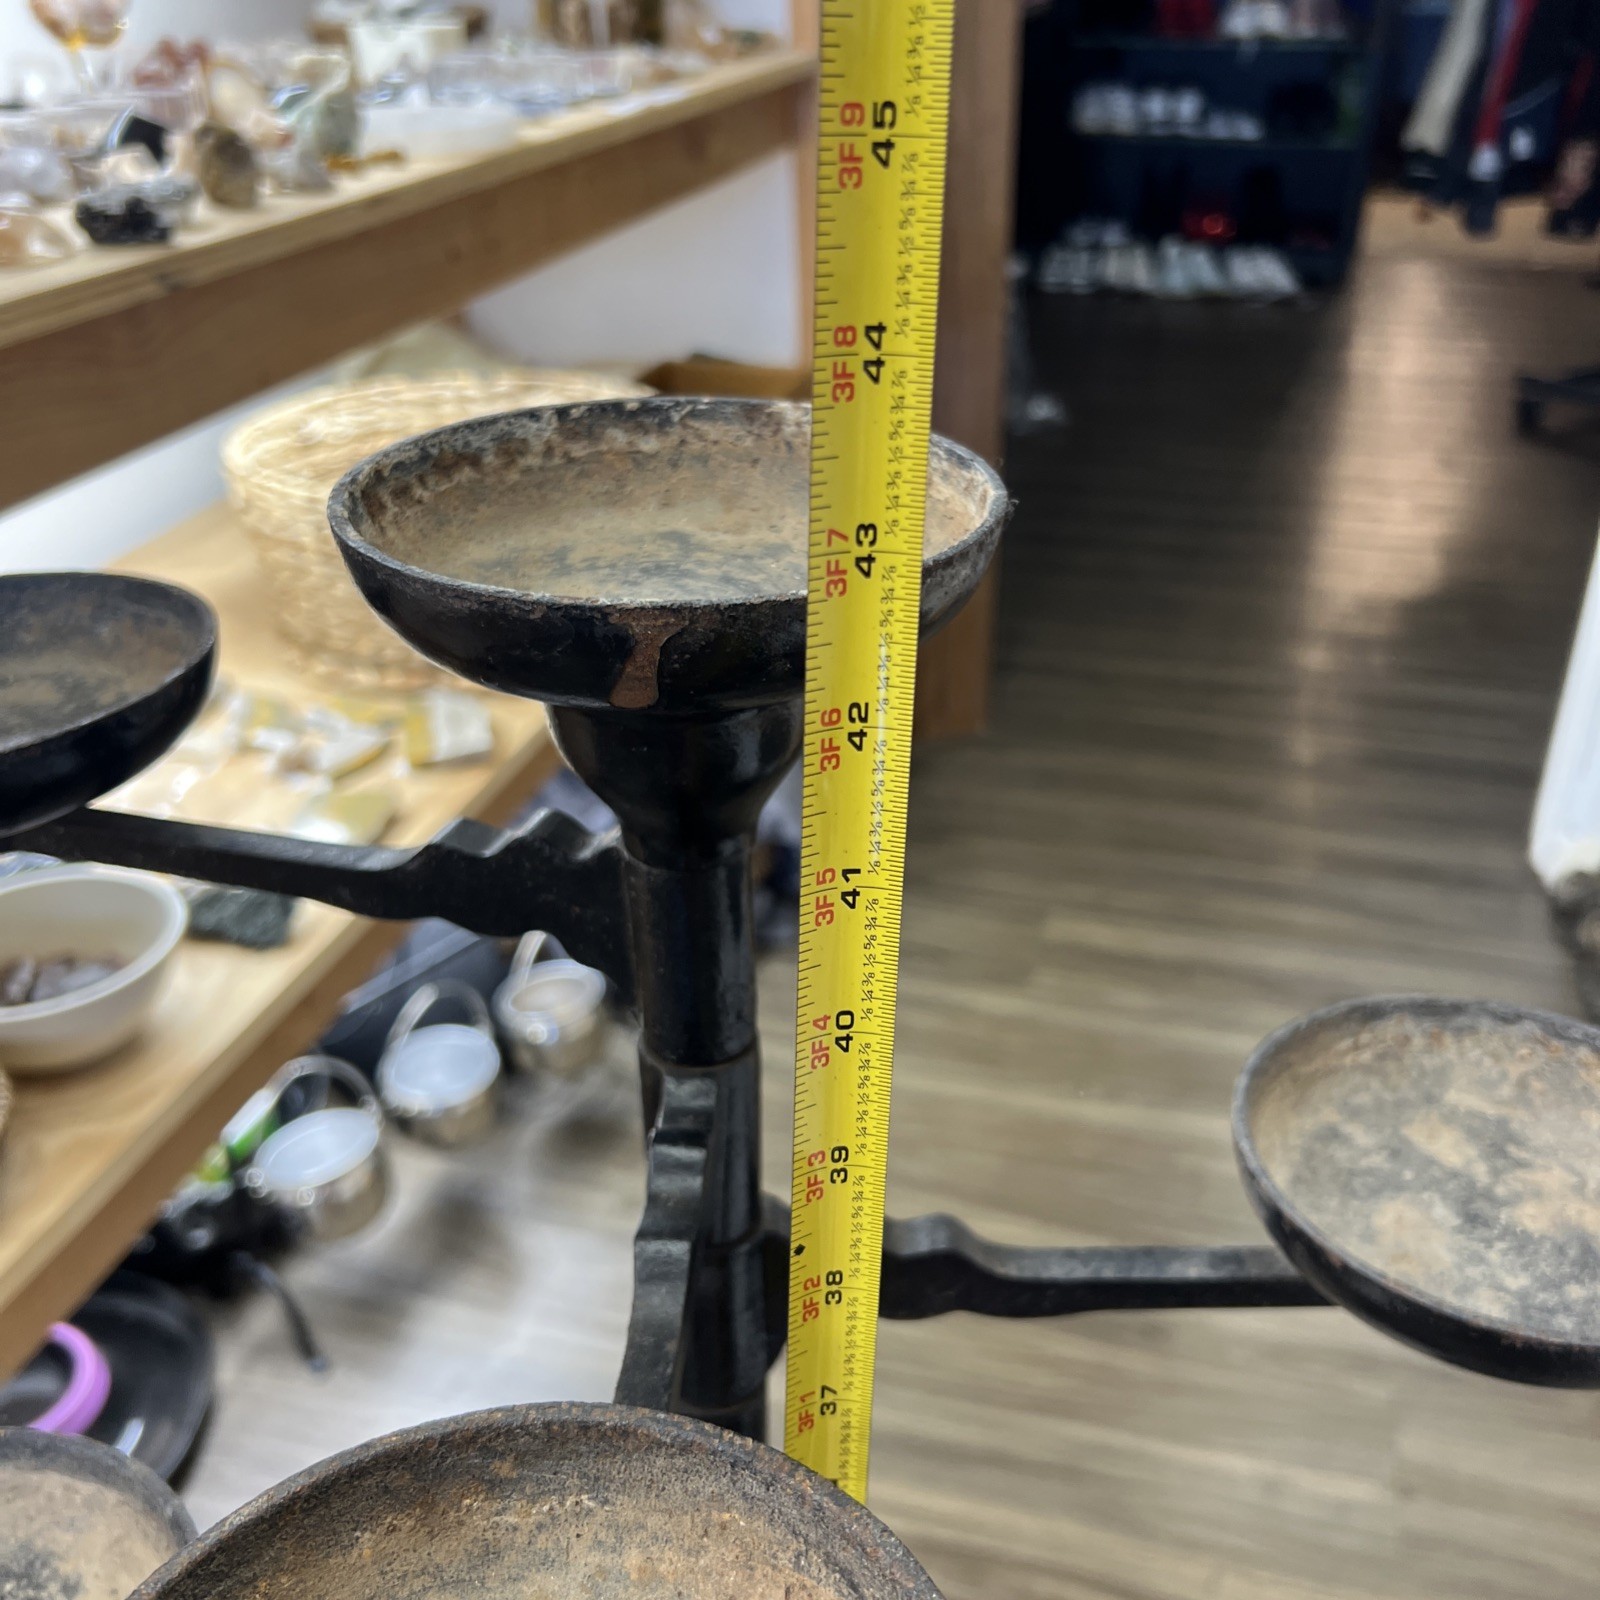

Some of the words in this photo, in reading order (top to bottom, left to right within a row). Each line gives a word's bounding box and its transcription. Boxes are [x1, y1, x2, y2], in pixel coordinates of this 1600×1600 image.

[872, 100, 896, 169] 45
[863, 322, 887, 384] 44
[855, 523, 878, 579] 43
[848, 702, 868, 752] 42
[868, 860, 880, 875] 1/8
[841, 868, 861, 909] 41
[866, 898, 879, 913] 7/8
[865, 916, 877, 930] 3/4
[864, 934, 877, 950] 5/8
[863, 954, 876, 968] 1/2
[862, 972, 875, 986] 3/8
[862, 990, 874, 1003] 1/4
[860, 1008, 874, 1022] 1/8
[835, 1010, 854, 1052] 40
[859, 1042, 872, 1056] 7/8
[858, 1058, 870, 1072] 3/4
[858, 1075, 870, 1089] 5/8
[858, 1092, 870, 1106] 1/2
[856, 1110, 869, 1123] 3/8
[830, 1146, 849, 1184] 39
[825, 1270, 843, 1305] 38
[820, 1385, 837, 1416] 37
